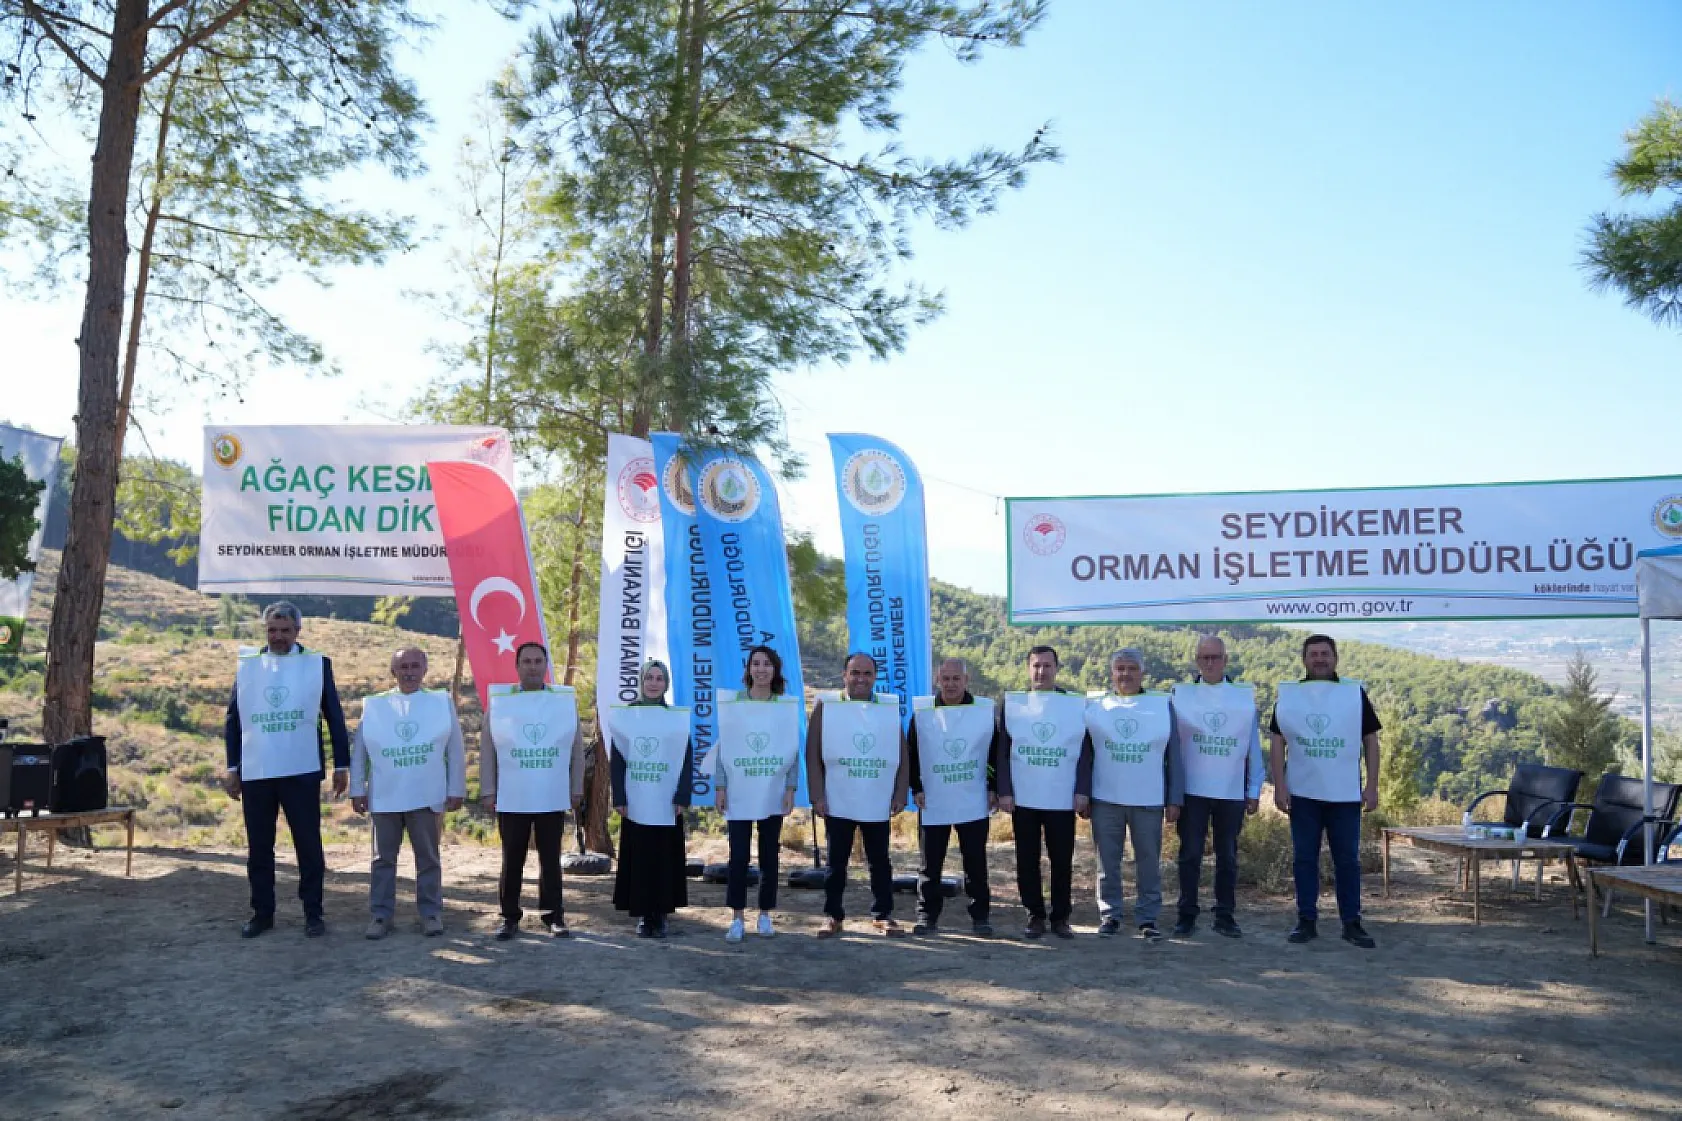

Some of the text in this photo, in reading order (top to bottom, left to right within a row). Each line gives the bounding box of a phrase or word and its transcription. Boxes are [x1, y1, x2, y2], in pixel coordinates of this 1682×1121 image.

[240, 458, 432, 499] AĞAÇ KESM
[267, 498, 435, 532] FİDAN DİK
[1221, 504, 1464, 540] SEYDİKEMER
[218, 543, 448, 559] SEYDİKEMER ORMAN İŞLETME MÜDÜR
[1071, 537, 1633, 585] ORMAN İŞLETME MÜDÜRLÜĞÜ
[1534, 582, 1591, 593] köklerinde
[1266, 599, 1413, 616] www.ogm.gov.tr
[520, 759, 553, 768] NEFES
[744, 767, 776, 777] NEFES
